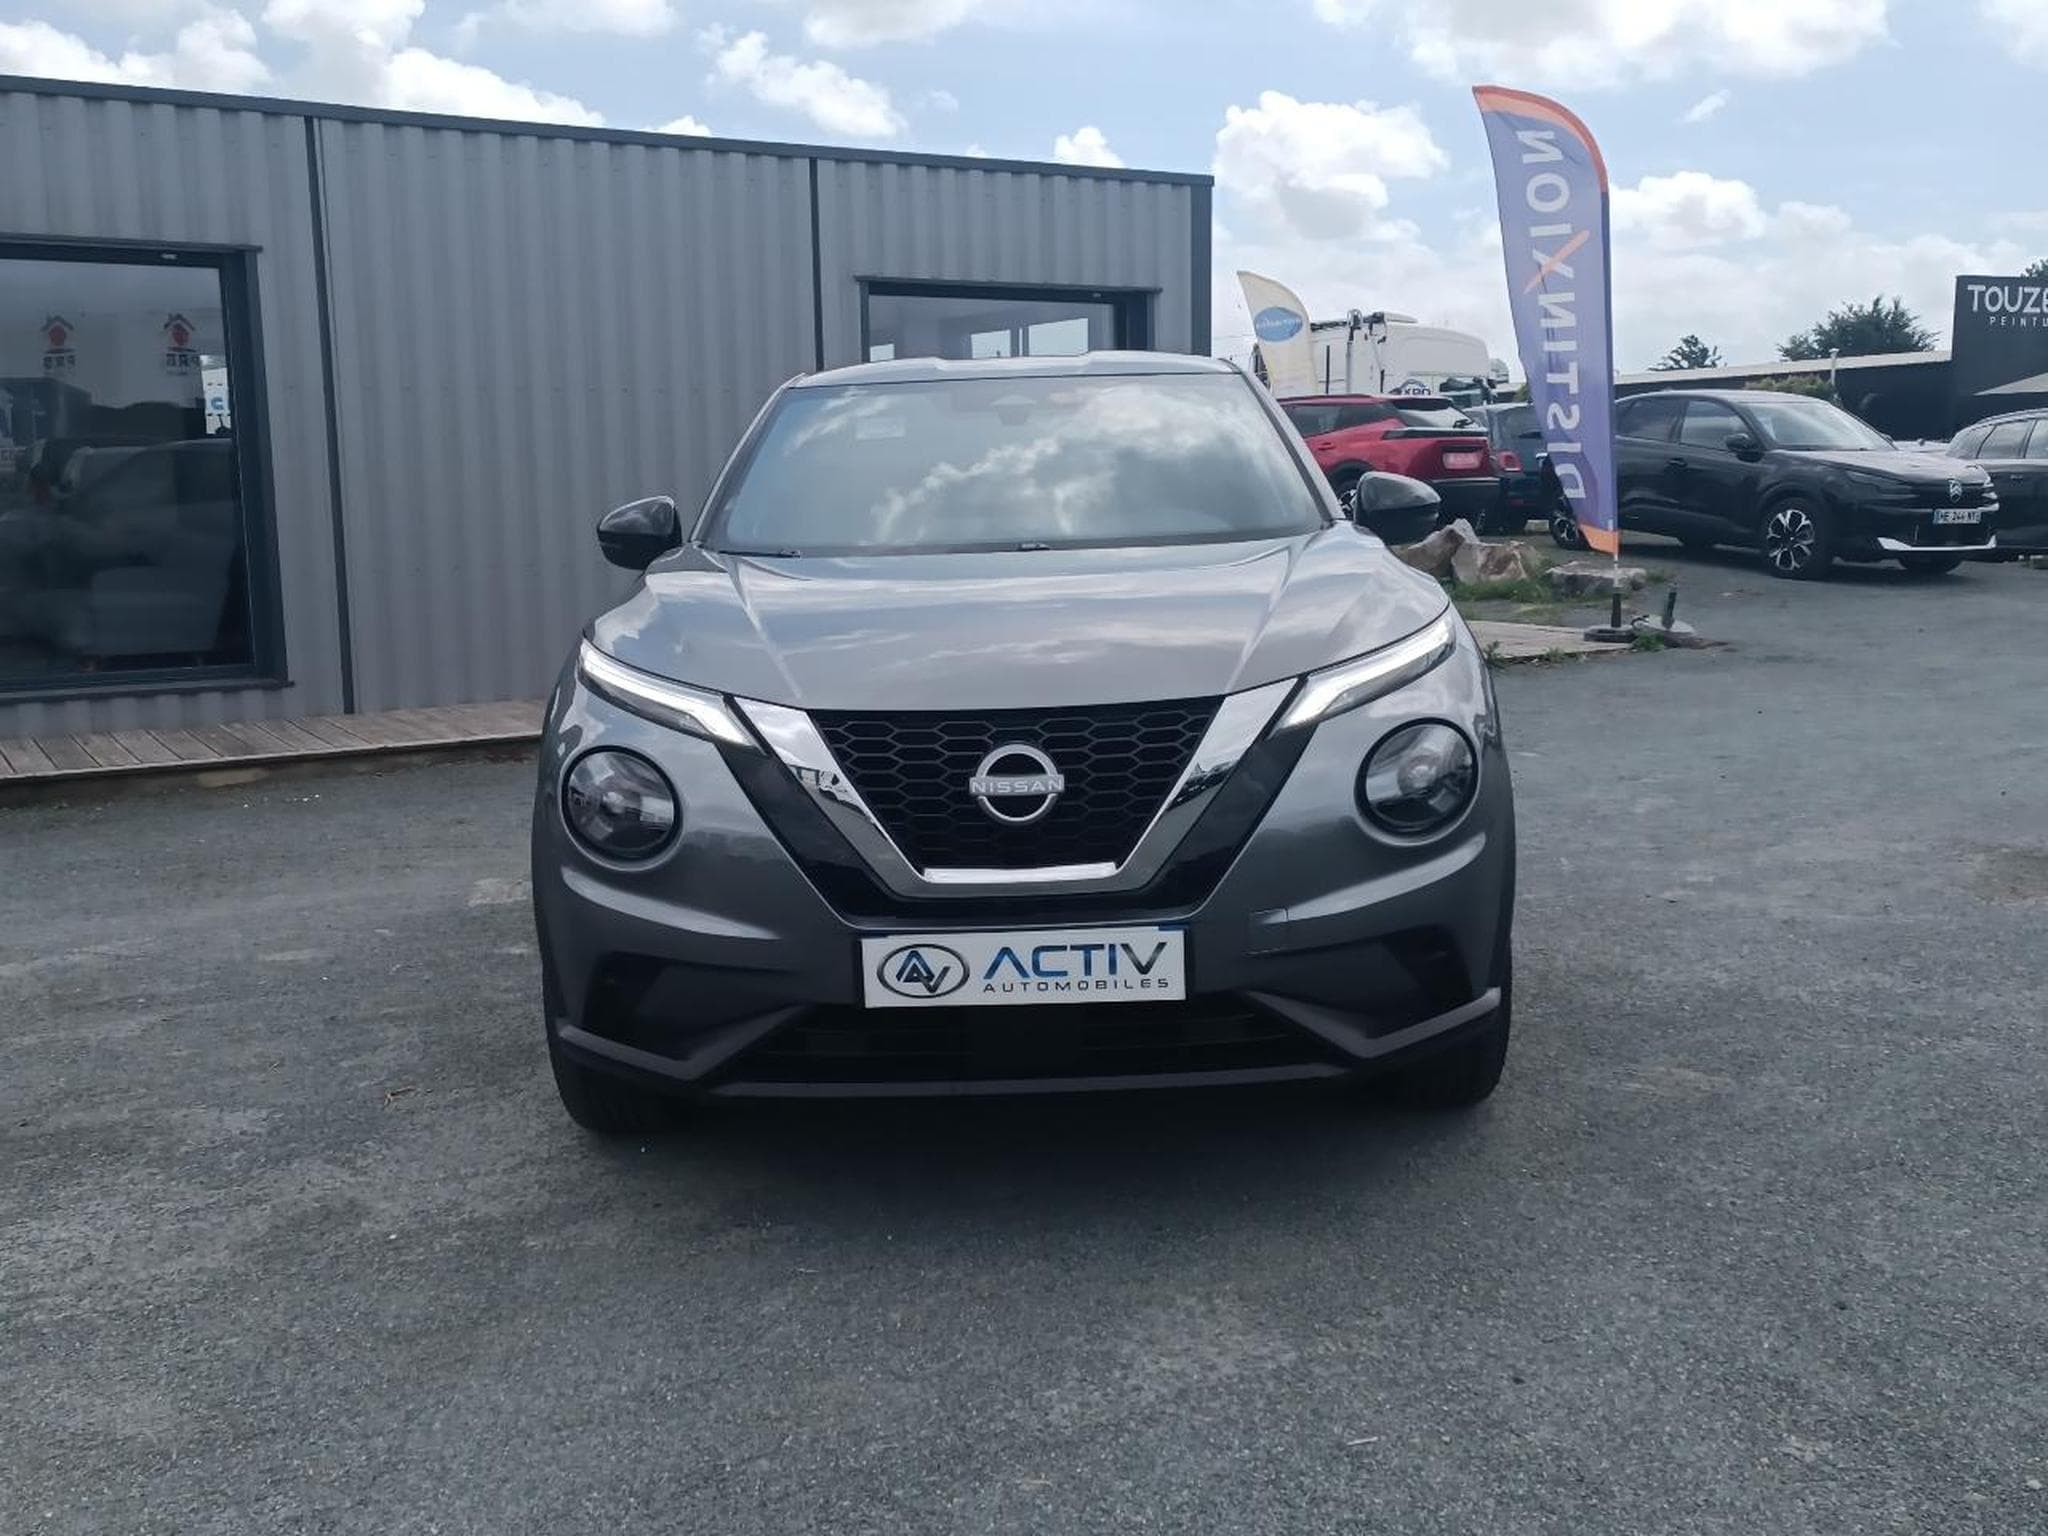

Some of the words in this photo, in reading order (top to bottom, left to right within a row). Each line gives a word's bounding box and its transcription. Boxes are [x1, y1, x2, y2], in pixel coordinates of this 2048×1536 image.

[971, 779, 1062, 793] NISSAN
[983, 941, 1168, 980] ACTIV
[983, 977, 1169, 993] AUTOMOBILES
